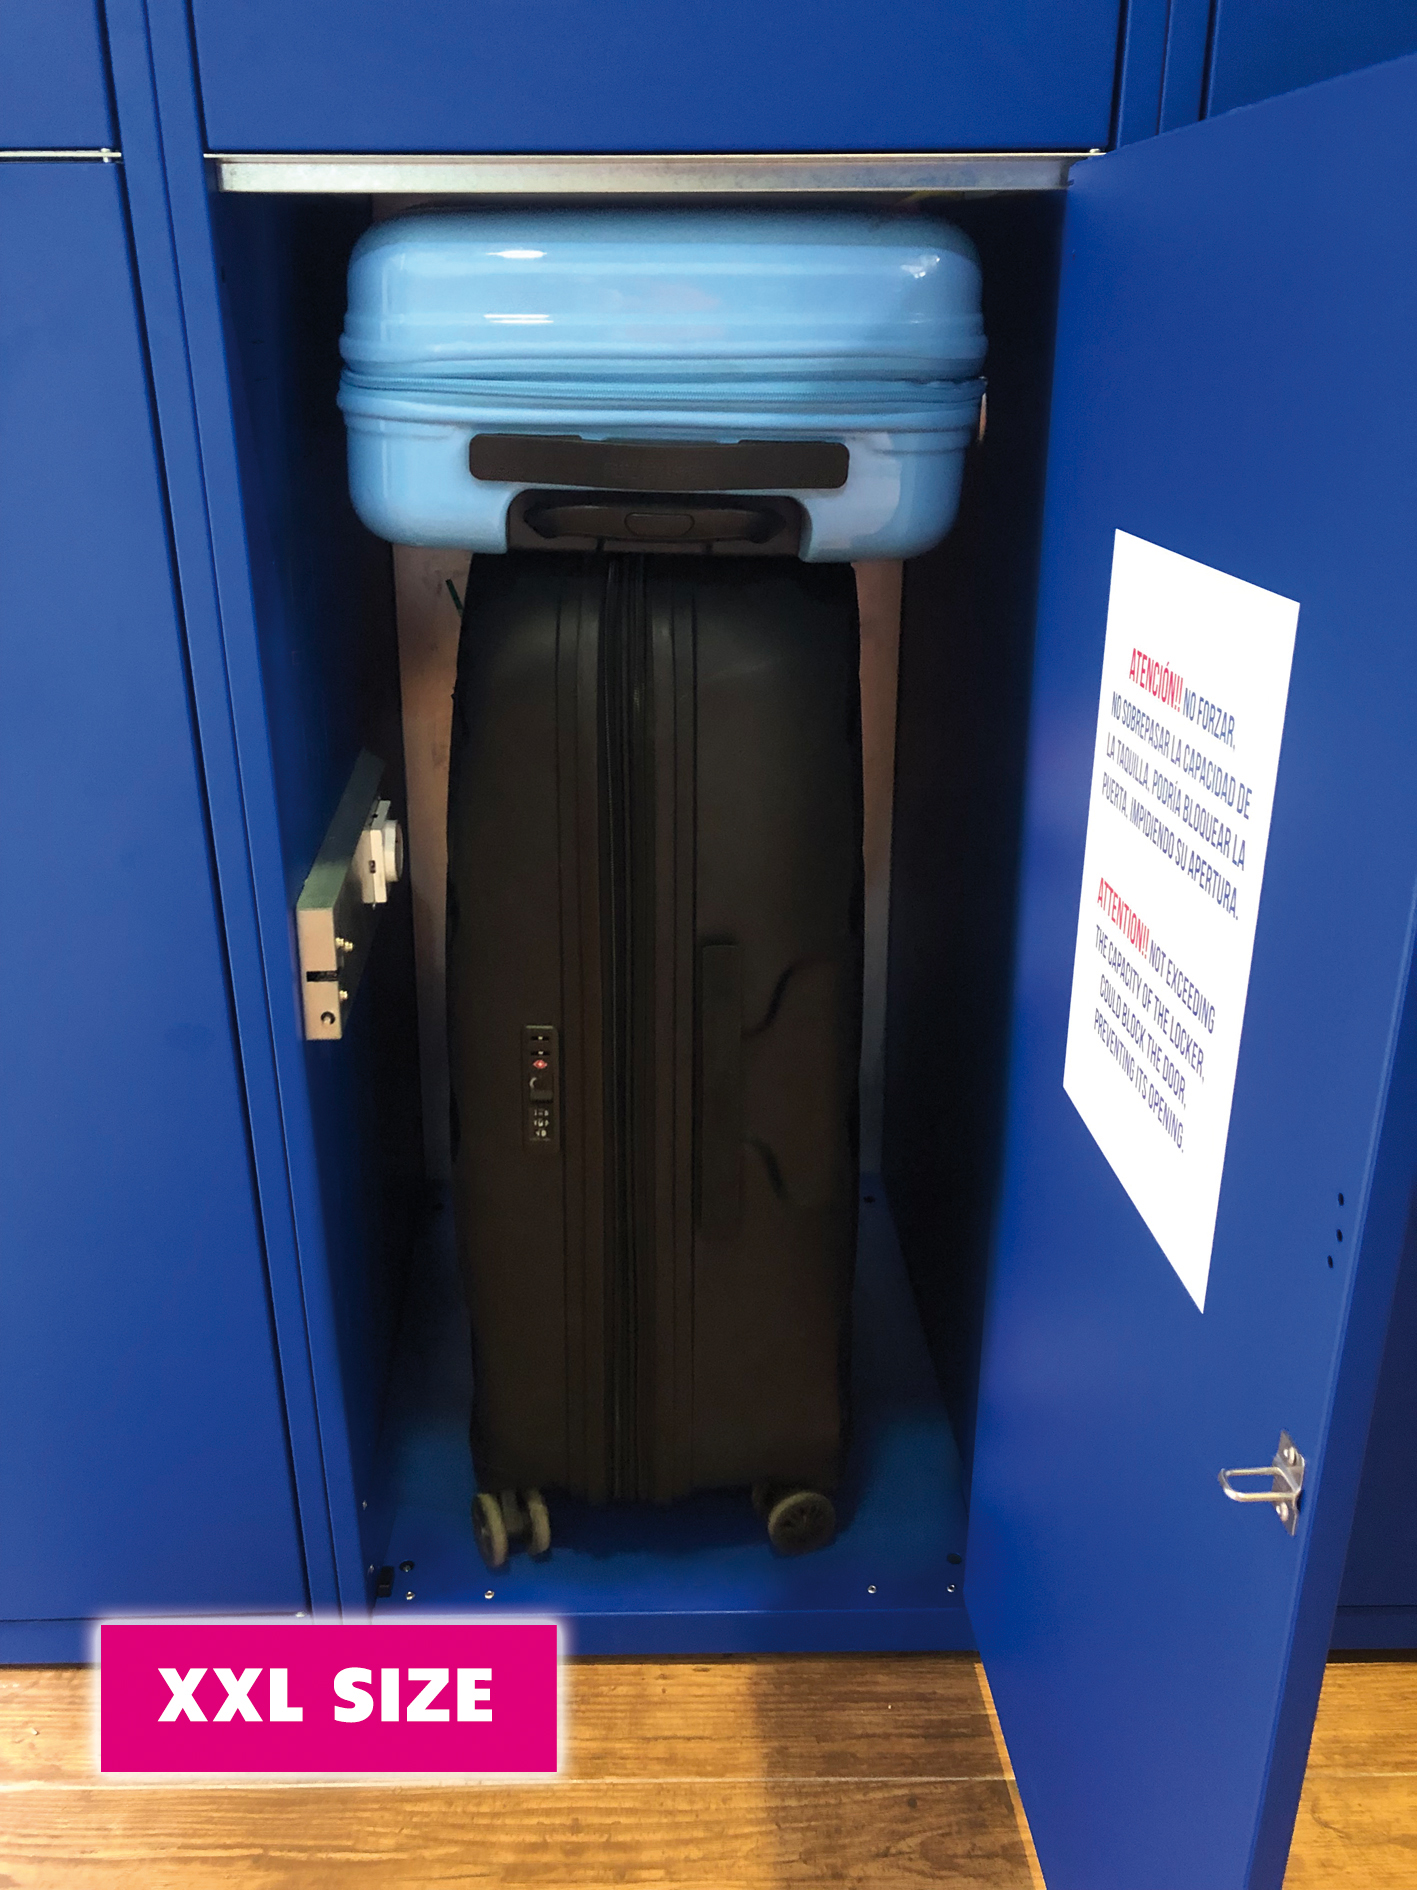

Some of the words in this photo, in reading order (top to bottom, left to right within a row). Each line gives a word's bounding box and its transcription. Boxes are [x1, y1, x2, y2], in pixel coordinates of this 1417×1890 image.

[1129, 648, 1183, 712] ATENCIÓN!!
[1183, 688, 1196, 721] NO
[1106, 732, 1115, 760] LA
[1151, 769, 1181, 816] PODRÍA
[1183, 794, 1231, 858] BLOQUEAR
[1232, 834, 1245, 871] LA
[1111, 691, 1121, 720] NO
[1121, 699, 1171, 758] SOBREPASAR
[1171, 735, 1181, 767] LA
[1183, 744, 1235, 807] CAPACIDAD
[1236, 783, 1252, 820] DE
[1130, 797, 1174, 859] IMPIDIENDO
[1175, 838, 1187, 871] SU
[1188, 850, 1238, 920] APERTURA.
[1096, 924, 1108, 959] THE
[1108, 941, 1142, 1000] CAPACITY
[1142, 982, 1153, 1012] OF
[1154, 995, 1169, 1034] THE
[1097, 877, 1149, 959] ATTENTION!!
[1149, 940, 1166, 977] NOT
[1166, 959, 1215, 1034] EXCEEDING
[1094, 1008, 1135, 1082] PREVENTING
[1135, 1065, 1148, 1100] ITS
[1100, 974, 1120, 1019] COULD
[1122, 1002, 1146, 1052] BLOCK
[1147, 1033, 1161, 1072] THE
